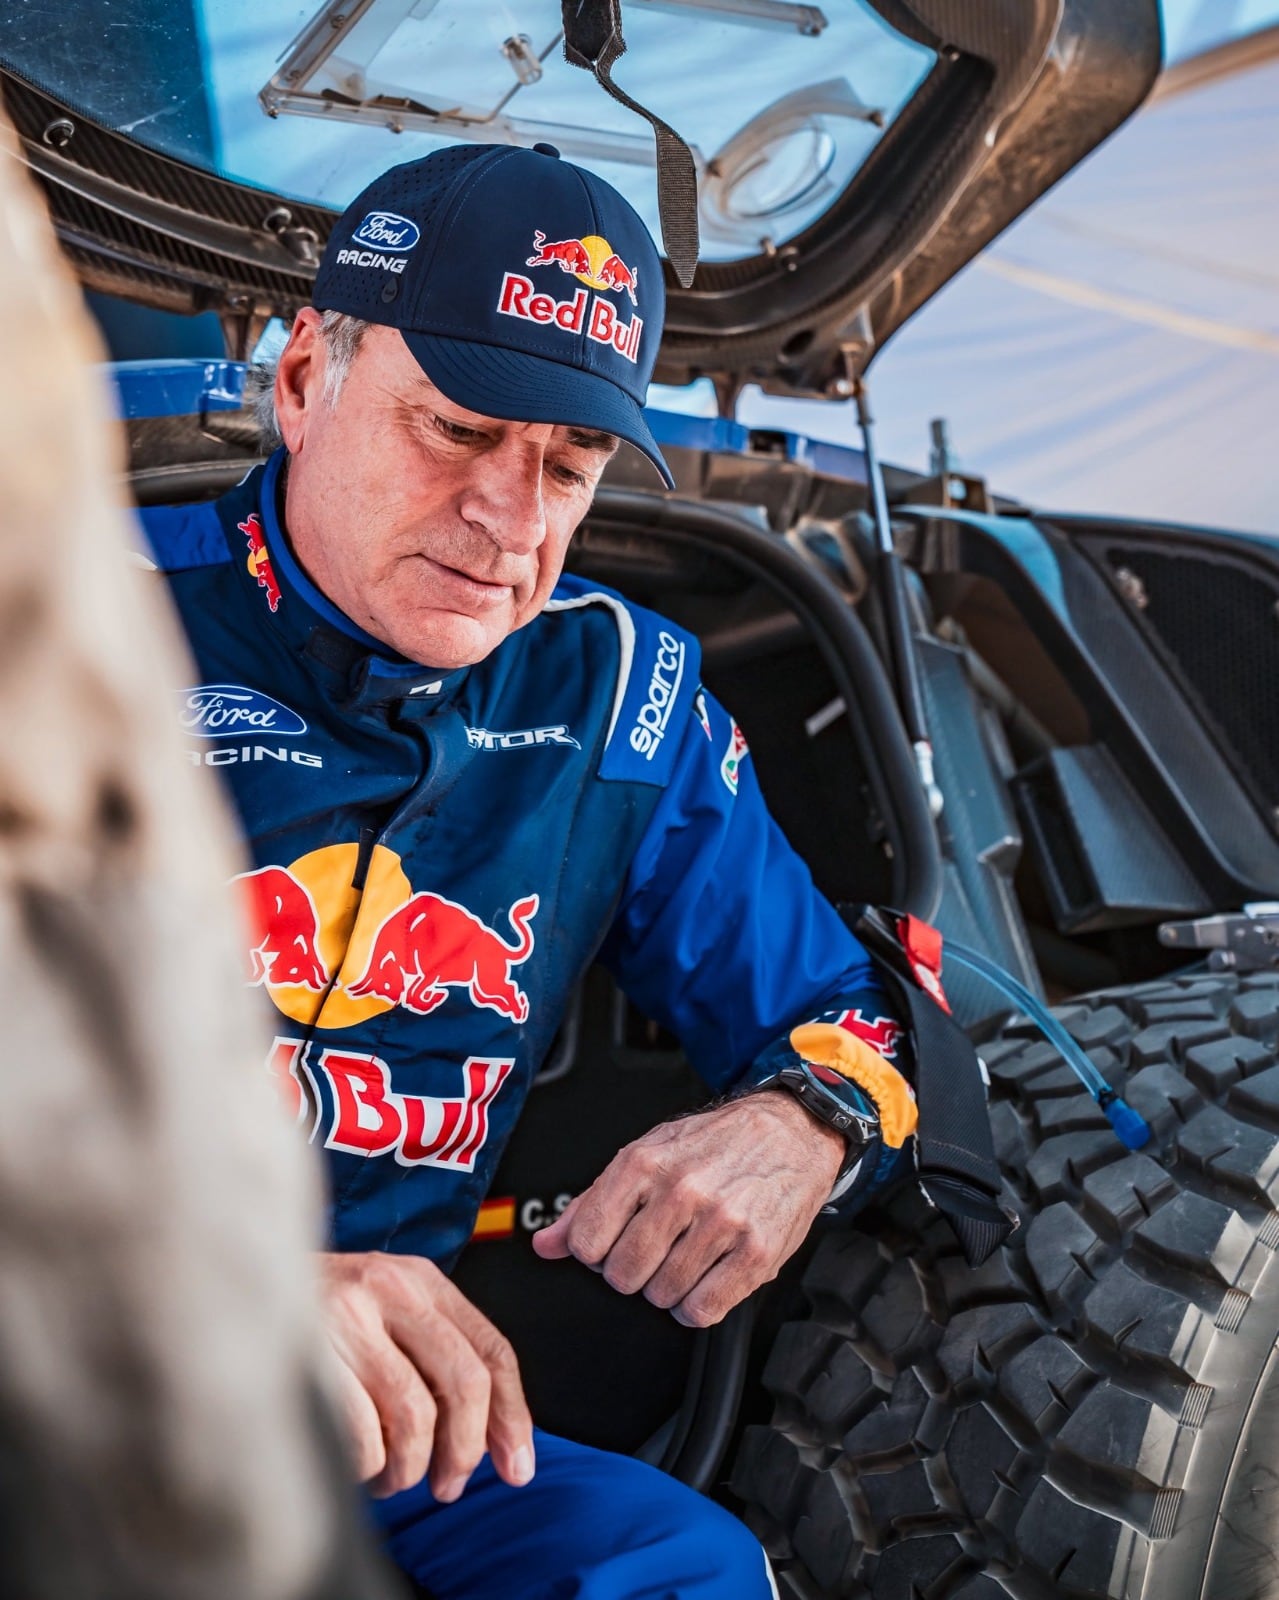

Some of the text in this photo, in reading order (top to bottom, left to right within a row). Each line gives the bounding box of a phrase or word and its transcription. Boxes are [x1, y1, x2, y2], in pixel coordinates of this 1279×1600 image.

[336, 249, 409, 275] RACING
[360, 215, 410, 246] Ford
[497, 272, 643, 364] Red Bull
[178, 692, 278, 727] Ford
[629, 631, 683, 757] sparco
[319, 1048, 516, 1173] Bull
